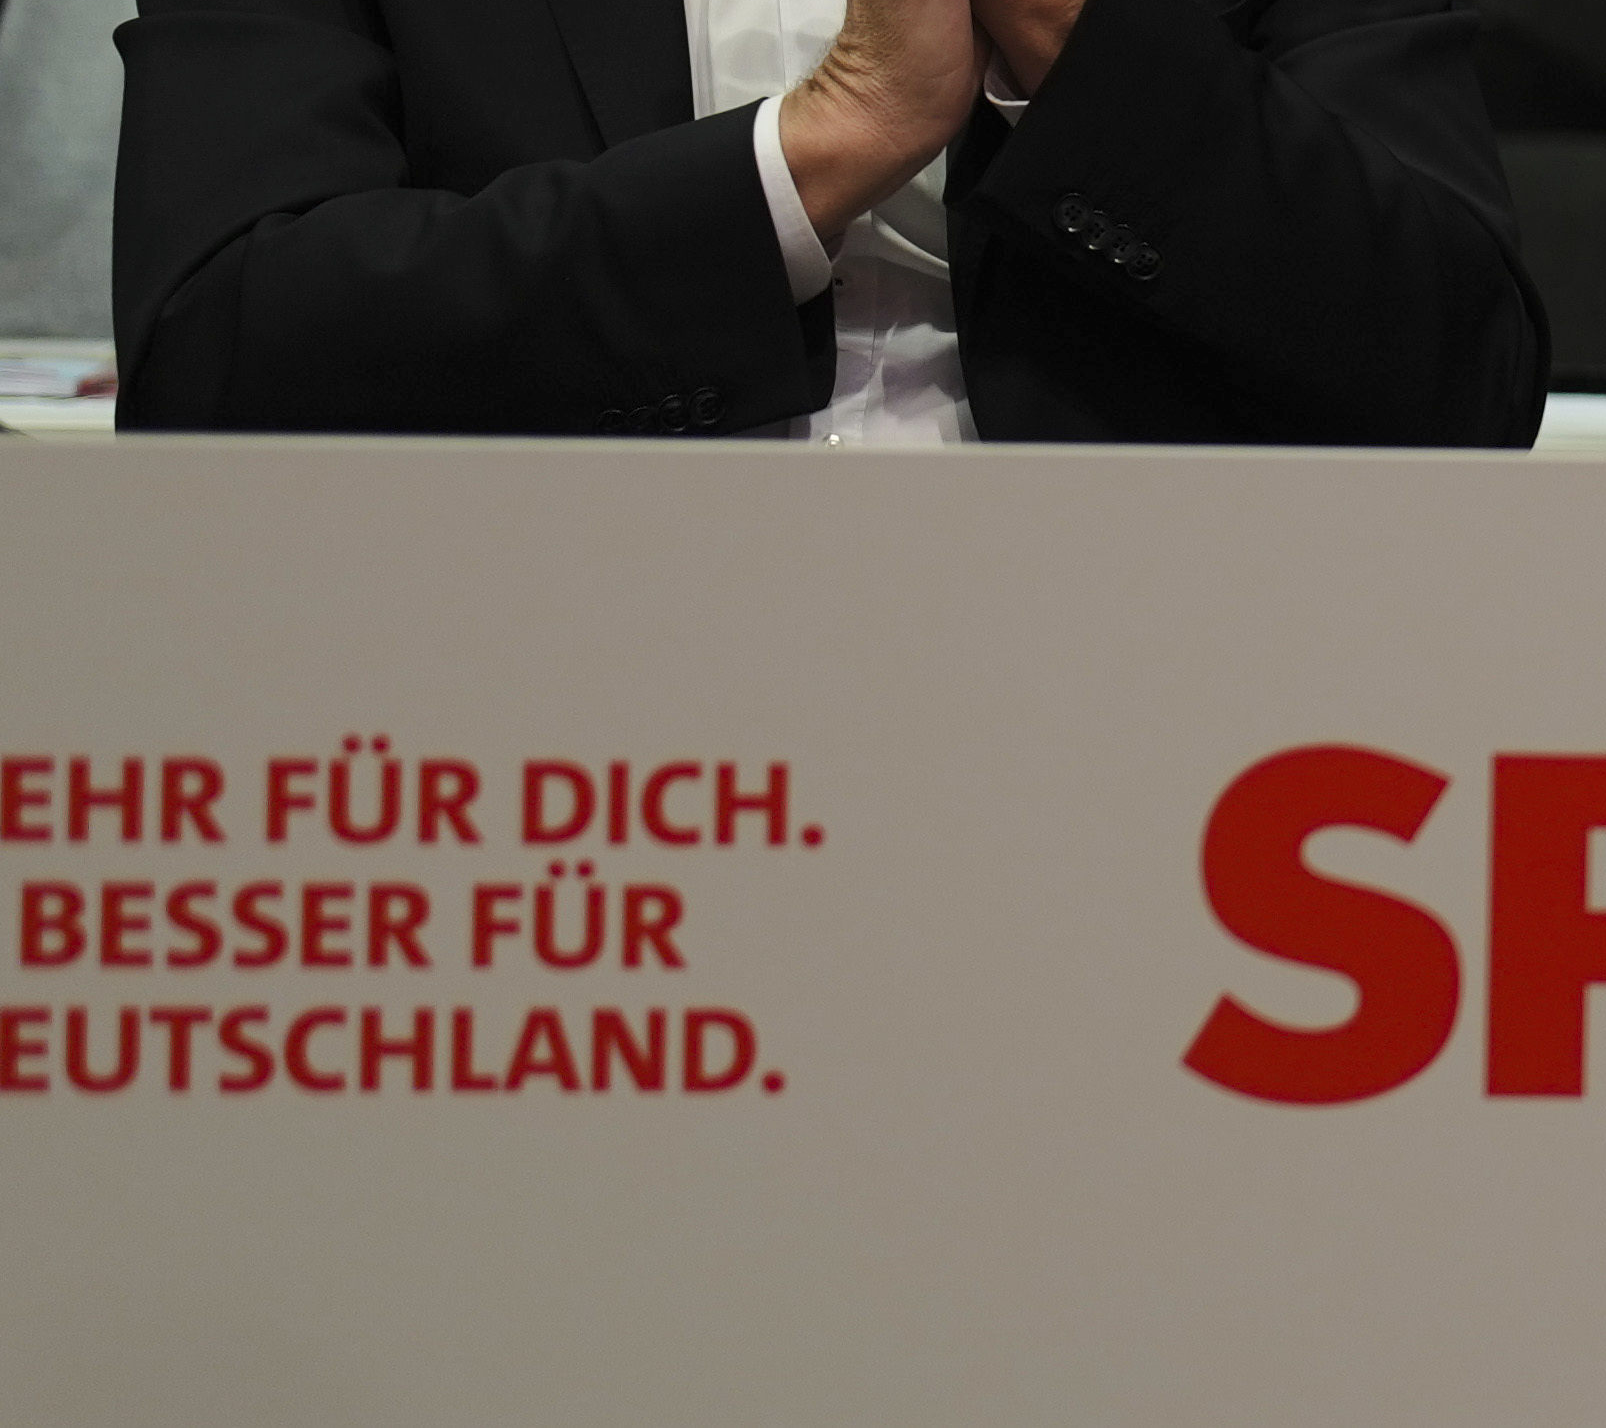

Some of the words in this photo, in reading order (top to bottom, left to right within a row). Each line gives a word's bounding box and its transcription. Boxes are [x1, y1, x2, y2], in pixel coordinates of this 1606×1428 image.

[267, 736, 480, 844] FÜR
[523, 760, 823, 847] DICH.
[21, 882, 431, 968] BESSER
[473, 861, 683, 969] FÜR
